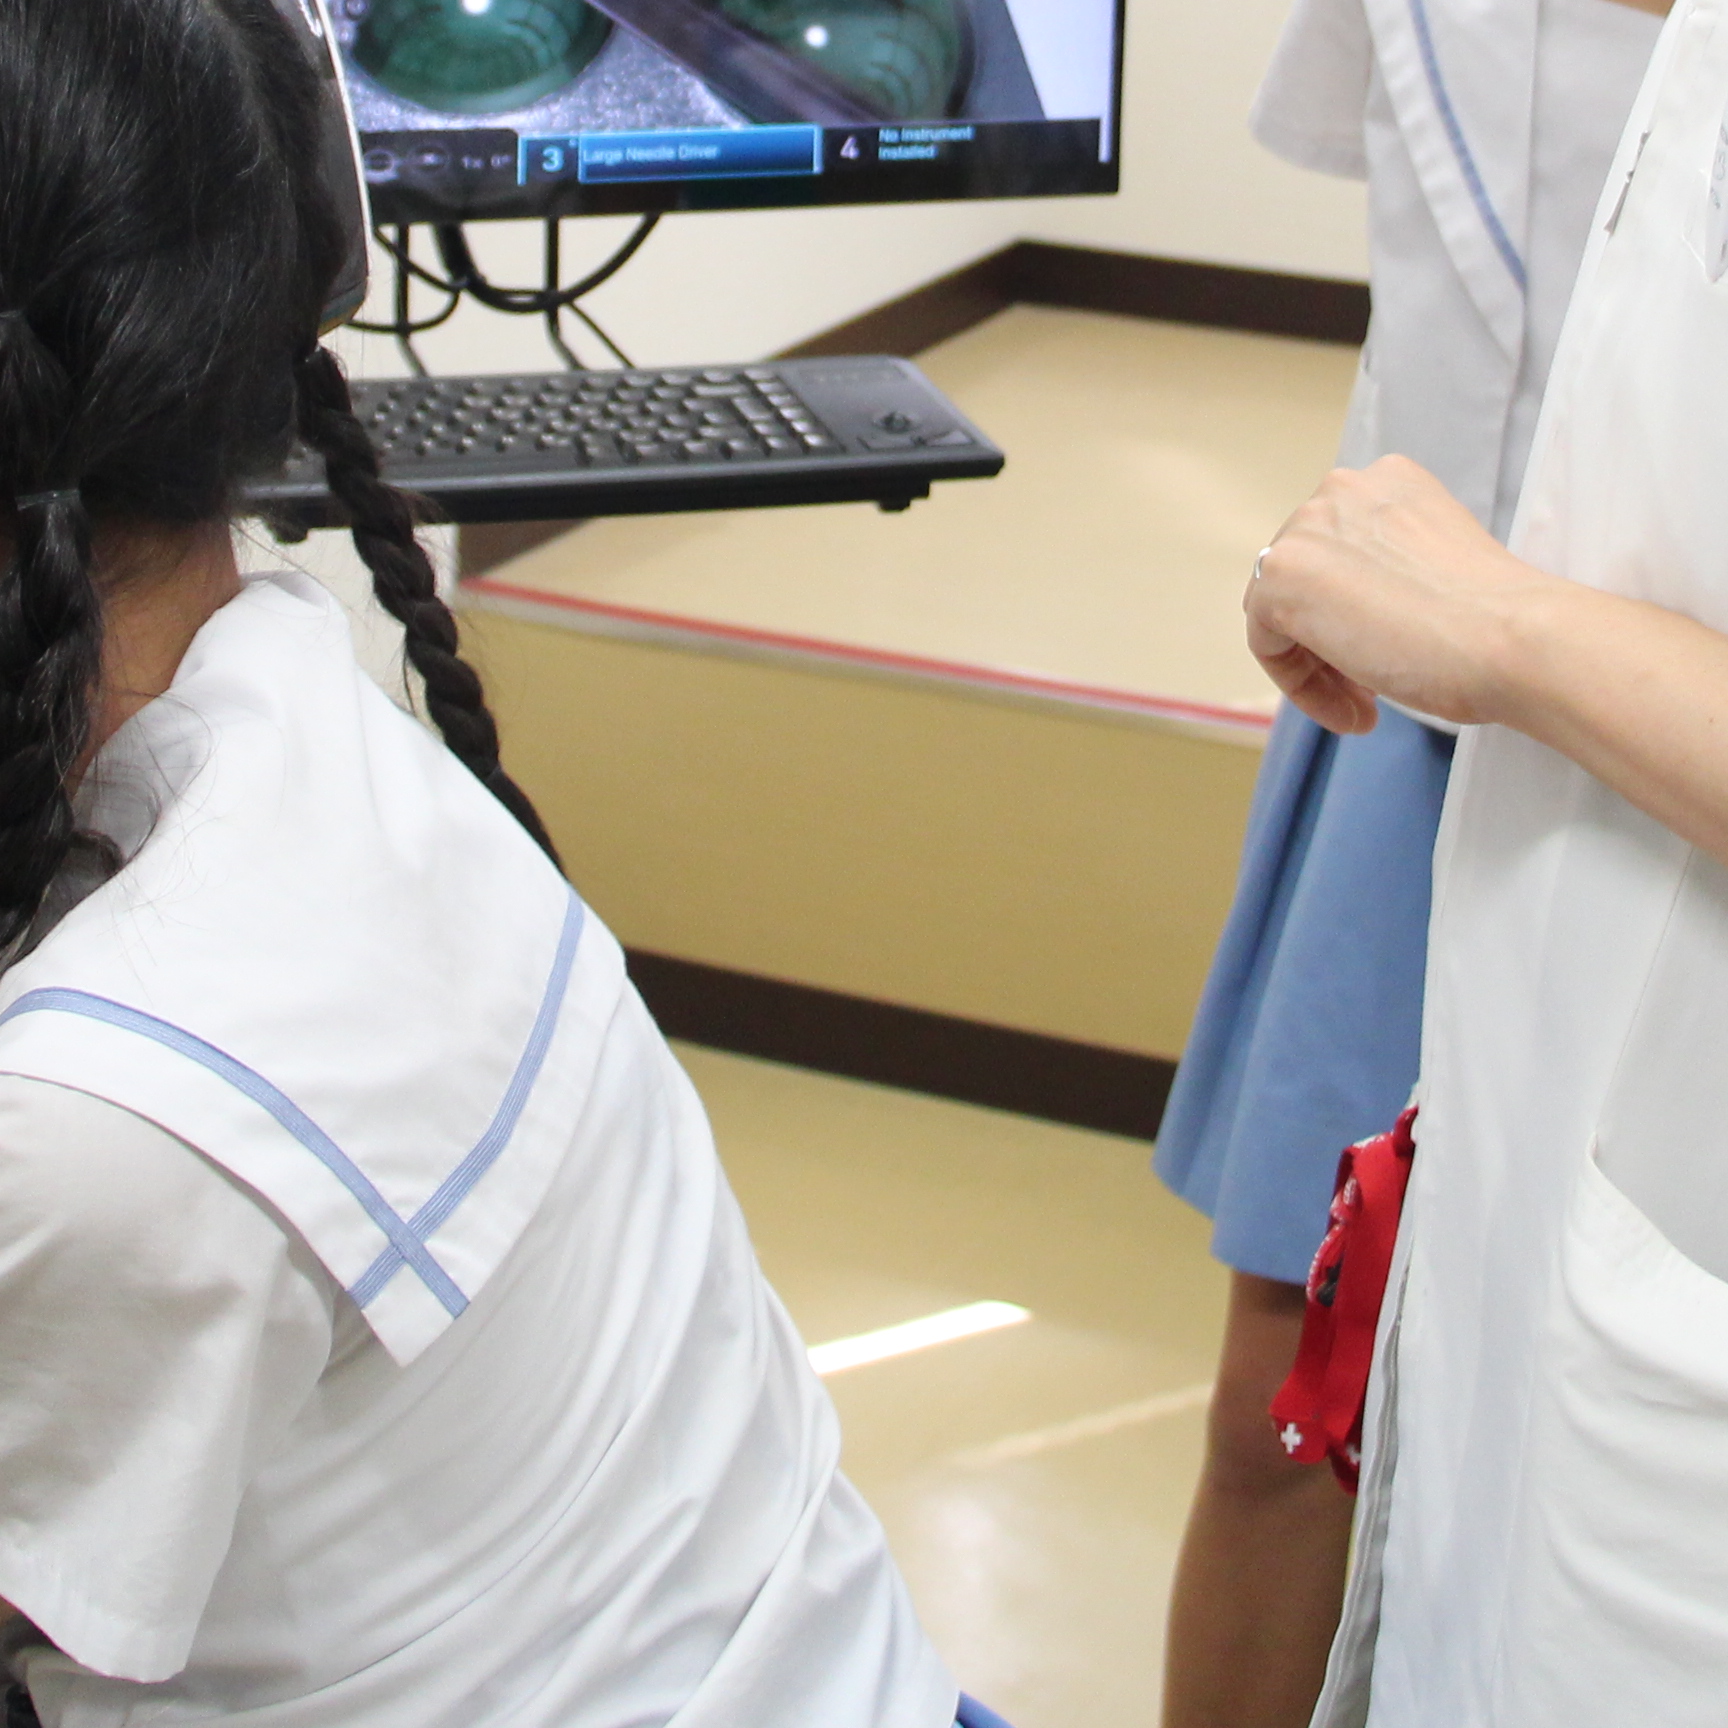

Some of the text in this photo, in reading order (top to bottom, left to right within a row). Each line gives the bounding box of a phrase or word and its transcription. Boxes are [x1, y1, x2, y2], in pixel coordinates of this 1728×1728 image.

[879, 125, 975, 143] No Instrument
[541, 145, 565, 173] 3
[583, 144, 718, 166] Large Needle Driver
[839, 135, 860, 160] 4
